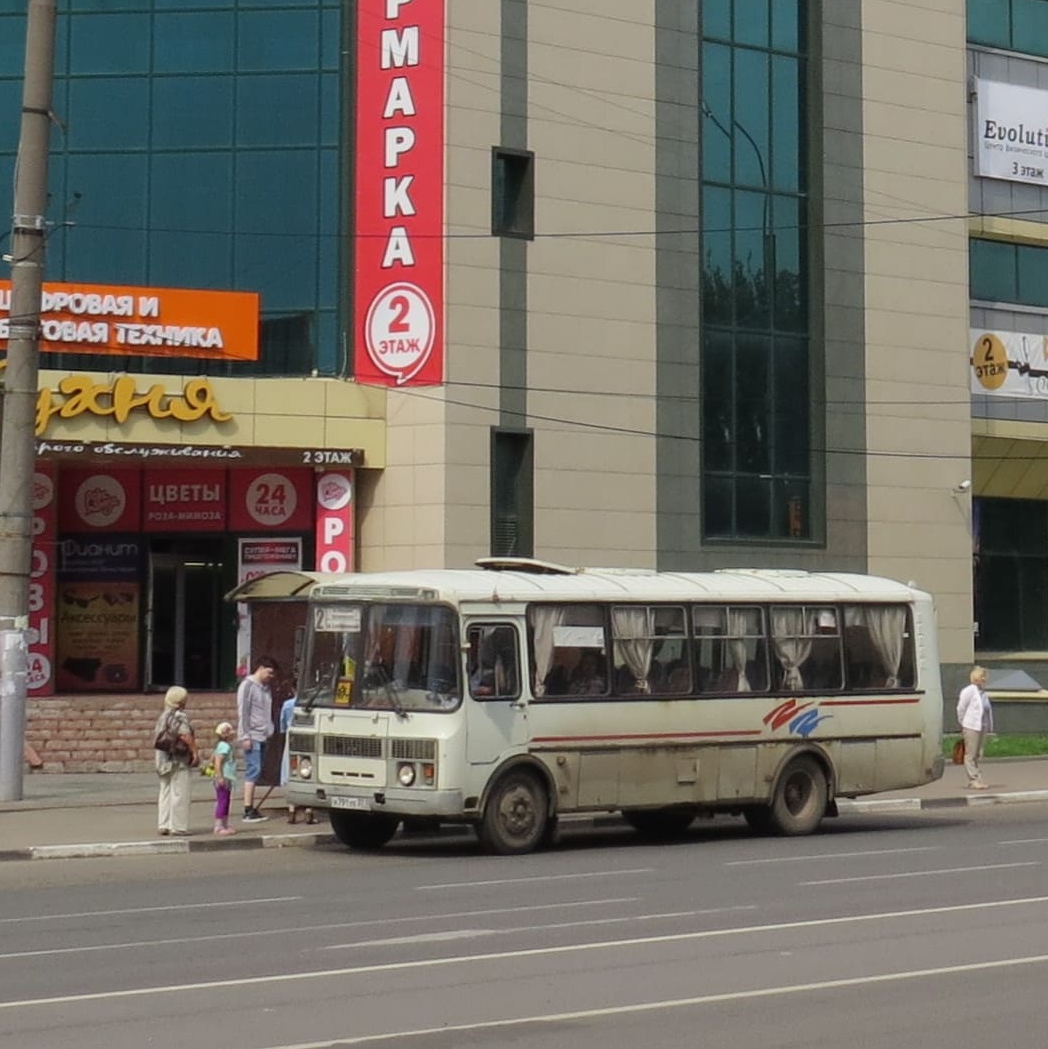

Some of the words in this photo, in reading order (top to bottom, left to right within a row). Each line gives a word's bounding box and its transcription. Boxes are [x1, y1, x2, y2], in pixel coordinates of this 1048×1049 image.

[1012, 161, 1019, 175] 3
[138, 296, 159, 318] И
[387, 295, 411, 333] 2
[115, 324, 224, 349] ТЕХНИКА
[378, 338, 421, 355] ЭТАЖ
[982, 337, 994, 361] 2
[975, 362, 1005, 379] этаж
[303, 451, 311, 463] 2
[313, 452, 352, 464] ЭТАЖ
[149, 484, 220, 504] ЦВЕТЫ
[255, 484, 287, 505] 24
[255, 505, 286, 516] ЧАСА
[316, 609, 325, 629] 2
